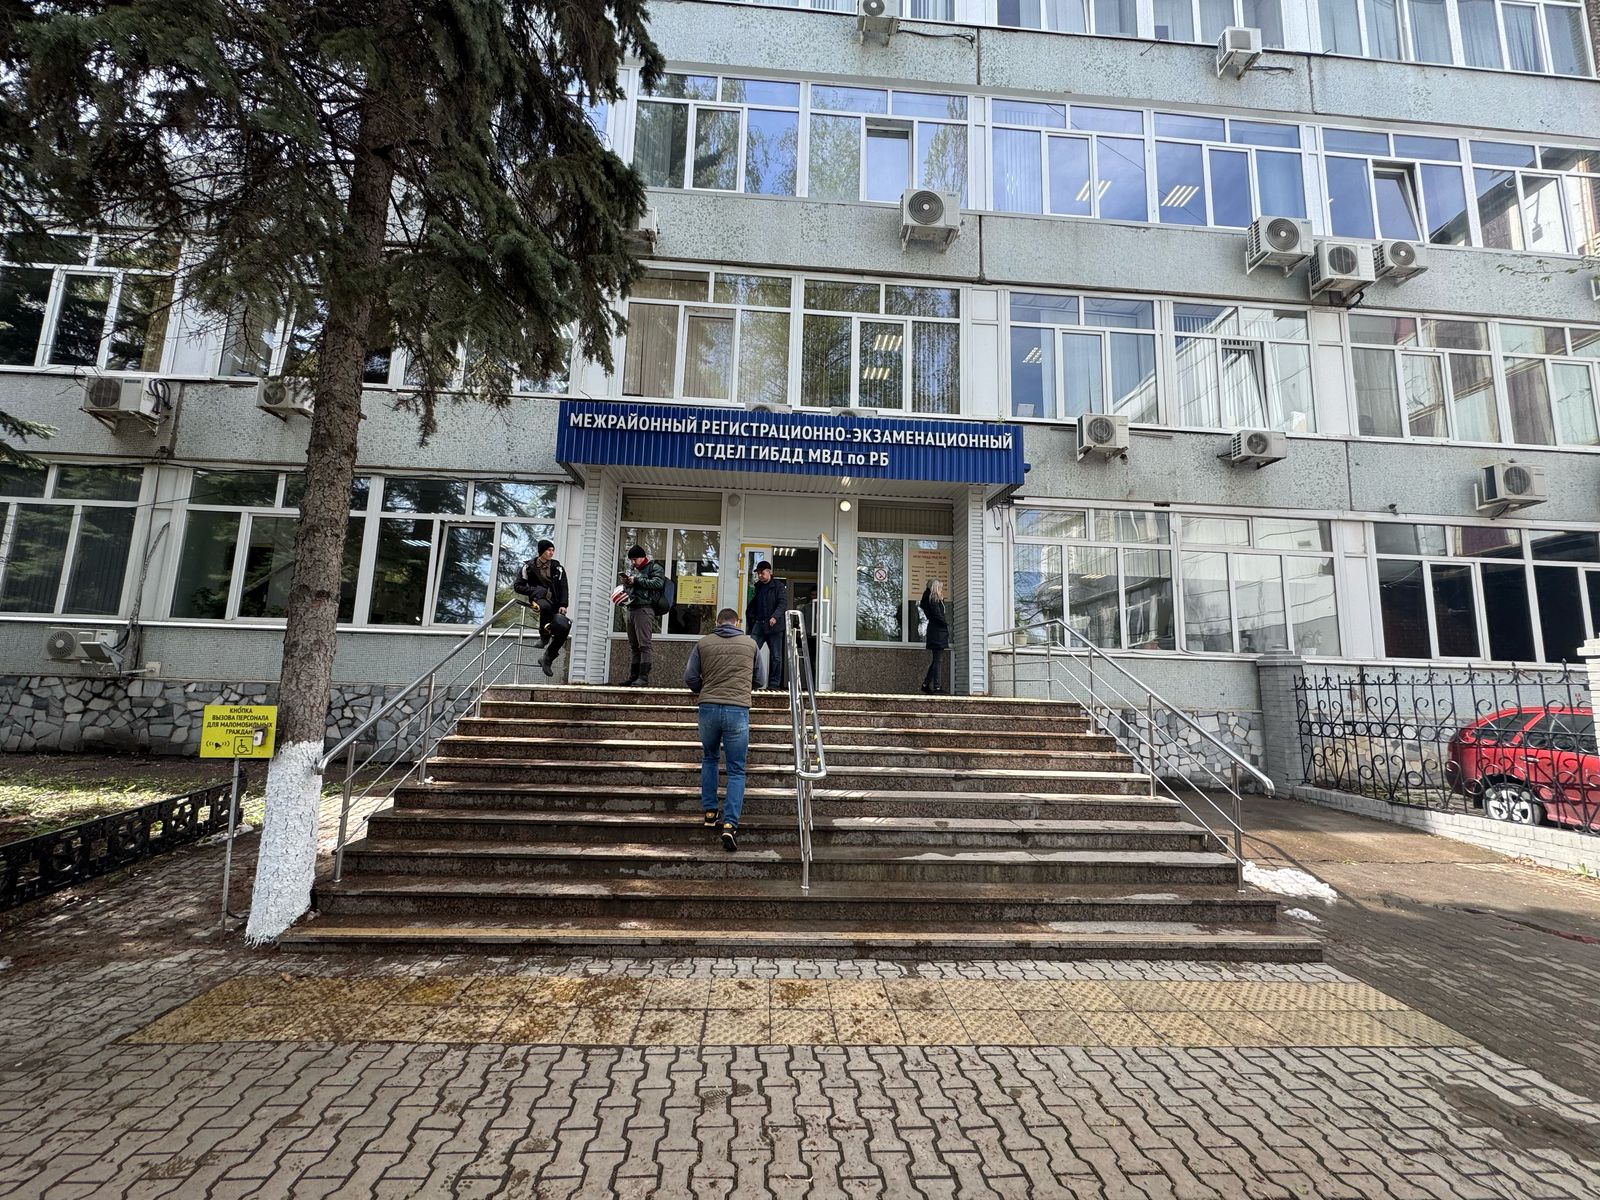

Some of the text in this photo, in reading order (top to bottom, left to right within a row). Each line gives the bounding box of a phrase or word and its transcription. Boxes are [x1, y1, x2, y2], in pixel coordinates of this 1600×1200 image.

[569, 412, 1013, 449] МЕЖРАЙОННЫЙ РЕГИСТРАЦИОННО-ЭКЗАМЕНАЦИОННЫЙ
[694, 442, 889, 466] ОТДЕЛ ГИБДД МВД по РБ
